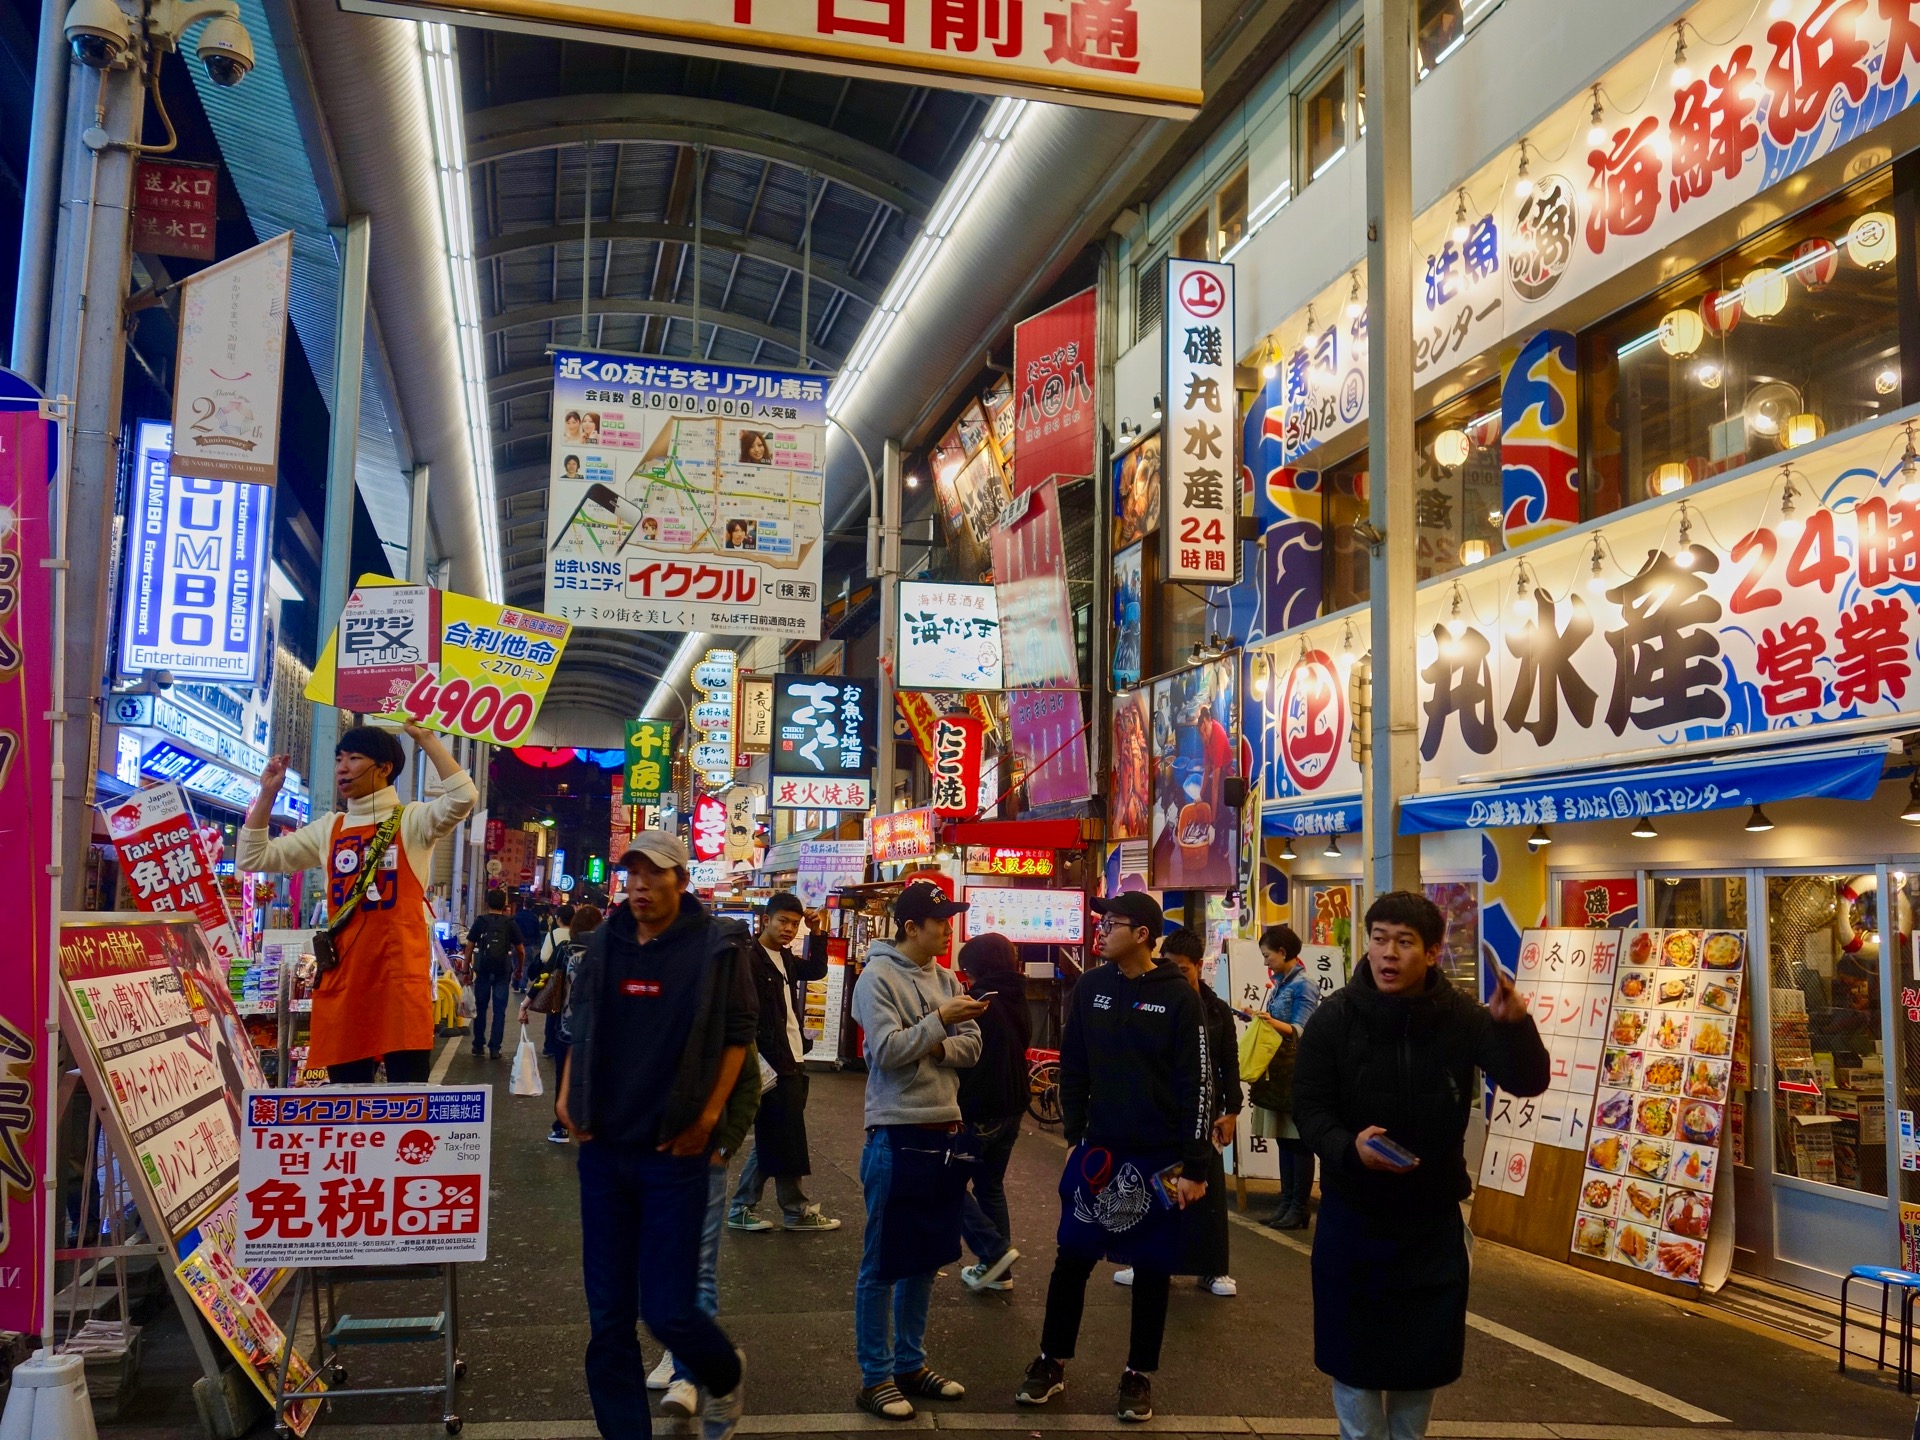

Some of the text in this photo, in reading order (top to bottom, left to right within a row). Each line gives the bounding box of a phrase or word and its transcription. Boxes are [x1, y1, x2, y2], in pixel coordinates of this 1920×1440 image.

[734, 0, 1141, 74] 日前通
[144, 172, 212, 195] 送水口
[142, 217, 207, 239] 送水口
[1425, 213, 1500, 312] 活魚
[1287, 323, 1338, 403] 寿司
[560, 357, 823, 401] 近くの友だちをリアル表示
[585, 389, 797, 420] 会員数 8,000,000 人突破
[1183, 325, 1224, 510] 磯丸水産
[1286, 395, 1336, 451] さかな
[202, 437, 247, 449] Anniversary
[215, 462, 246, 471] ORIENTAL
[1180, 517, 1226, 545] 24
[138, 460, 165, 636] JUMBO Entertainment
[1180, 549, 1226, 572] 時間
[554, 559, 621, 575] 出会いSNS
[553, 577, 623, 592] コミュニティ
[628, 562, 811, 602] イククル で 検索
[229, 568, 249, 642] JUMBO
[918, 593, 985, 610] 海鮮居酒屋
[345, 615, 414, 631] アリナミン
[711, 612, 806, 628] なんば千日前通商店会
[904, 610, 999, 646] 海だるま
[345, 629, 414, 653] EX
[445, 622, 557, 664] 合利他命
[135, 648, 244, 670] Entertainment
[357, 646, 419, 665] PLUS
[1756, 597, 1911, 717] 営業
[701, 720, 730, 728] はつせ
[840, 685, 863, 768] お魚と地酒
[630, 726, 662, 790] 千房
[933, 721, 967, 808] たこ焼
[146, 797, 176, 813] Tax-free
[147, 790, 174, 804] Japan.
[776, 781, 865, 807] 炭火焼鳥
[160, 804, 179, 816] Shop
[1486, 795, 1558, 826] 磯丸水産
[120, 826, 190, 863] Tax-Free
[130, 844, 202, 899] 免税
[990, 857, 1053, 874] 大阪名物
[258, 1001, 275, 1009] 298
[1140, 1003, 1166, 1014] AUTO
[252, 1094, 481, 1124] 薬 ダイコクドラッグ DAIKOKU DRUG
[1195, 1086, 1205, 1139] RACING
[1495, 1098, 1584, 1138] スタート
[252, 1128, 386, 1149] Tax-Free
[444, 1142, 481, 1151] Tax-free
[447, 1131, 481, 1141] Japan.
[279, 1151, 357, 1175] 면세
[456, 1152, 481, 1162] Shop
[402, 1178, 474, 1209] 8%
[244, 1177, 388, 1240] 免税
[397, 1208, 474, 1233] OFF
